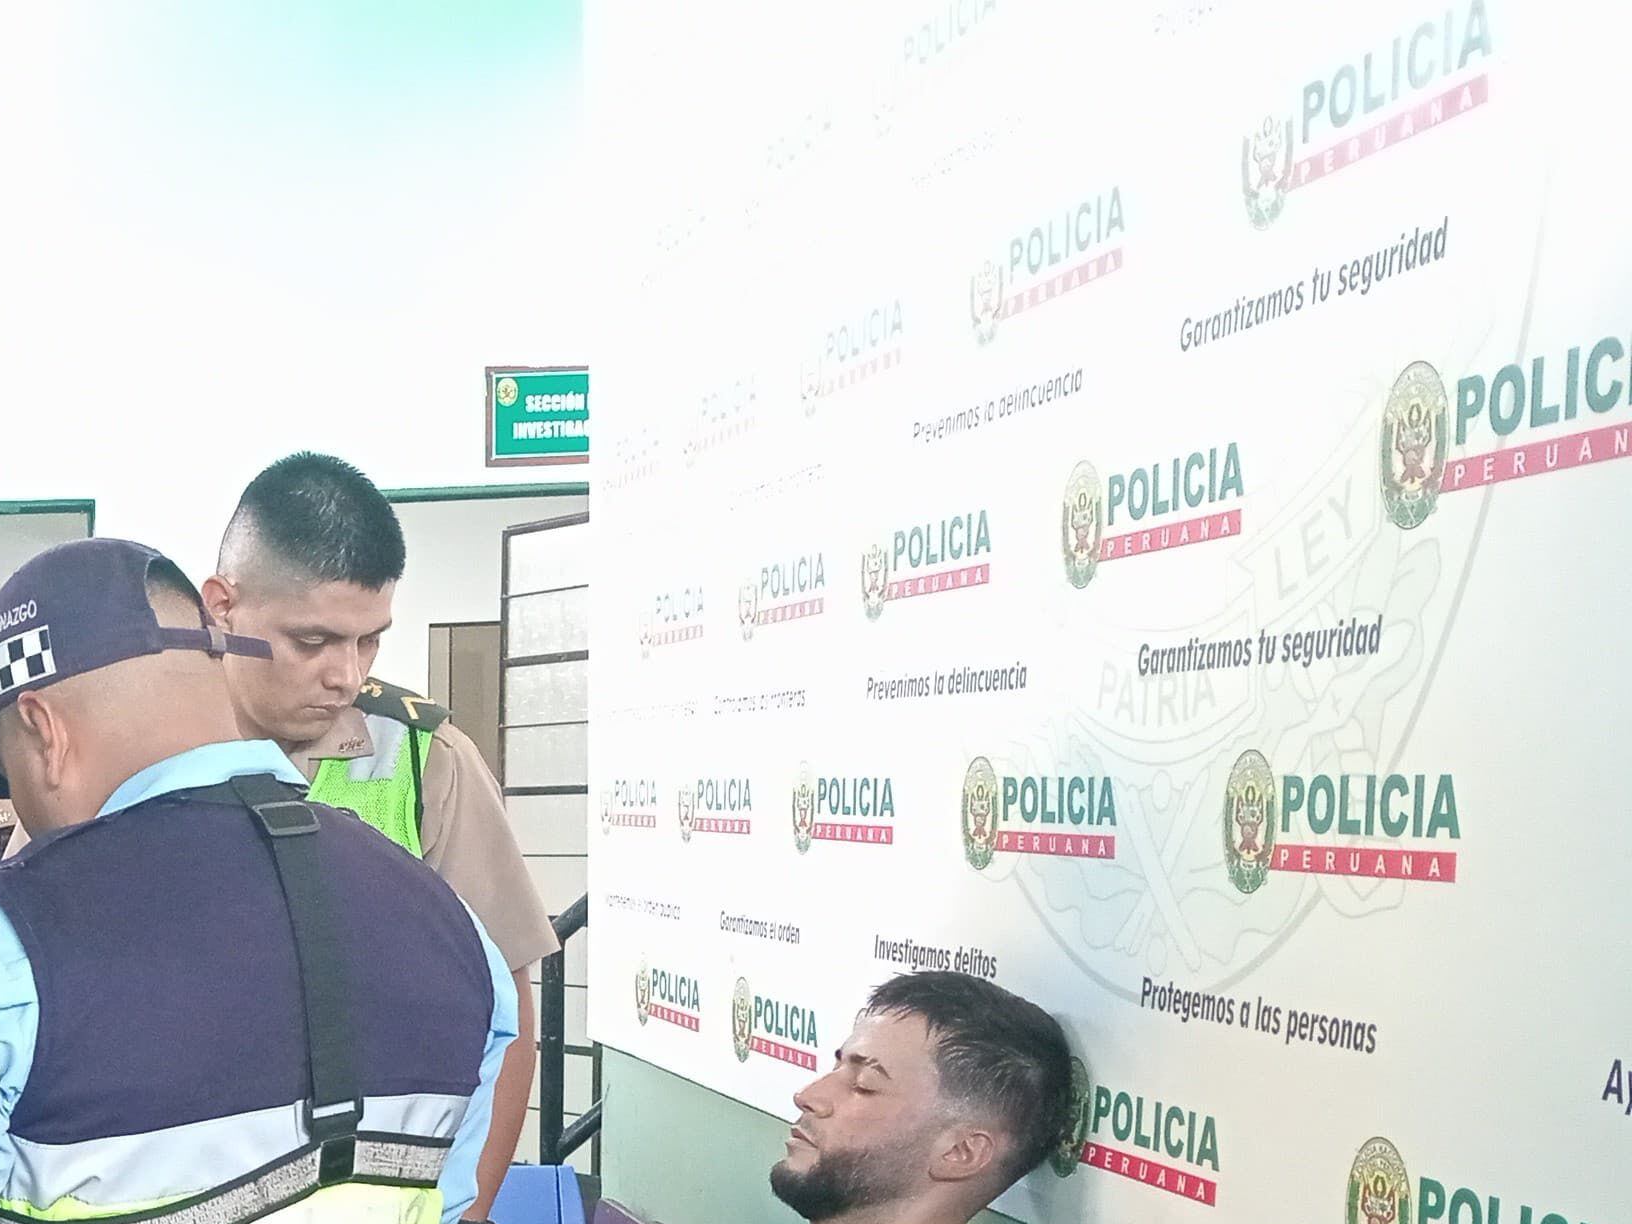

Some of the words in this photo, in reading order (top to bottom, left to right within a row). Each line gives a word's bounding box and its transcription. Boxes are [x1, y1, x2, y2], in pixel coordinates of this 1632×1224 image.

[1301, 0, 1493, 144] POLICIA
[1298, 85, 1474, 184] PERUANA
[1010, 185, 1125, 285] POLICIA
[1179, 278, 1305, 352] Garantizamos
[1311, 266, 1332, 306] tu
[1337, 216, 1448, 296] seguridad
[525, 390, 585, 413] SECCIÓN
[1456, 336, 1632, 446] POLIC
[1107, 441, 1244, 526] POLICIA
[1453, 427, 1629, 486] PERUAN
[893, 509, 992, 571] POLICIA
[1106, 516, 1232, 558] PERUANA
[761, 552, 825, 600] POLICIA
[1138, 634, 1252, 678] Garantizamos
[1258, 629, 1275, 664] tu
[1281, 614, 1382, 668] seguridad
[866, 669, 930, 703] Prevenimos
[932, 672, 944, 696] la
[947, 660, 1027, 696] delincuencia
[697, 778, 752, 811] POLICIA
[816, 776, 895, 818] POLICIA
[1001, 775, 1117, 827] POLICIA
[1281, 773, 1461, 840] POLICIA
[1001, 833, 1106, 857] PERUANA
[1279, 850, 1441, 878] PERUANA
[720, 910, 768, 939] Garantizamos
[769, 922, 776, 940] el
[778, 922, 800, 944] orden
[874, 934, 951, 970] Investigamos
[954, 946, 997, 978] delitos
[652, 968, 700, 1012] POLICIA
[1141, 976, 1235, 1027] Protegemos
[1239, 1001, 1250, 1028] a
[1256, 995, 1282, 1035] las
[1286, 1010, 1377, 1054] personas
[754, 995, 818, 1048] POLICIA
[1602, 1059, 1632, 1115] A
[1091, 1085, 1220, 1171] POLICIA
[1087, 1146, 1207, 1200] PERUANA
